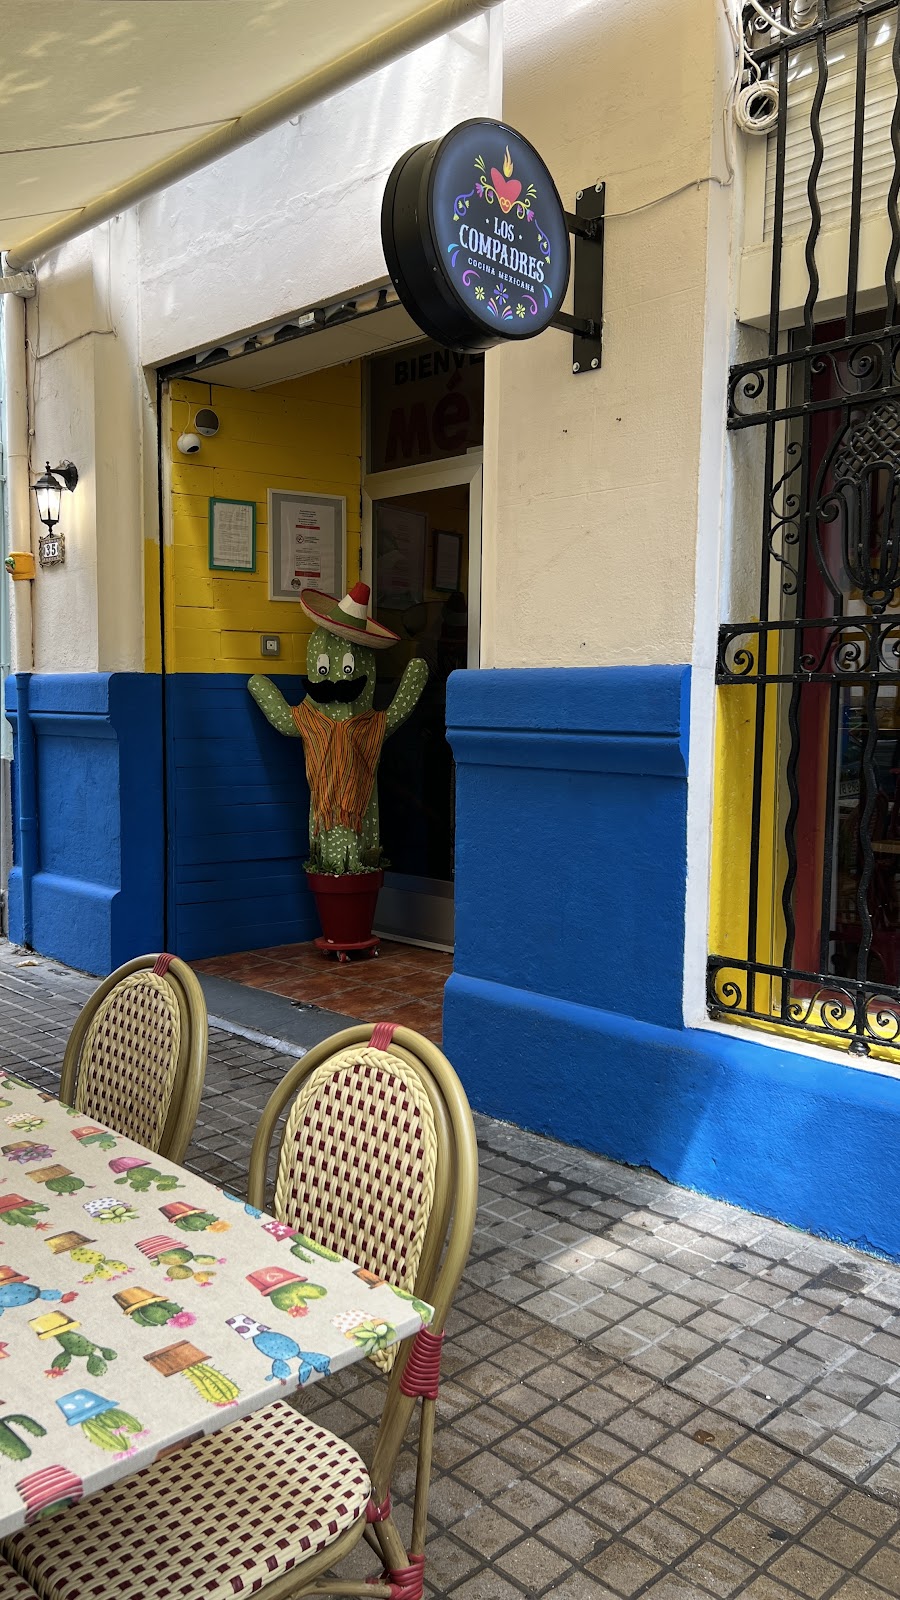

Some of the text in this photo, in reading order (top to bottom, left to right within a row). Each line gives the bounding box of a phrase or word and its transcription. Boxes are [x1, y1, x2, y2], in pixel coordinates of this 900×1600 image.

[494, 217, 515, 242] LOS
[459, 224, 545, 283] COMPADRES
[468, 257, 535, 293] COCINA MEXICANA
[46, 544, 56, 556] 35
